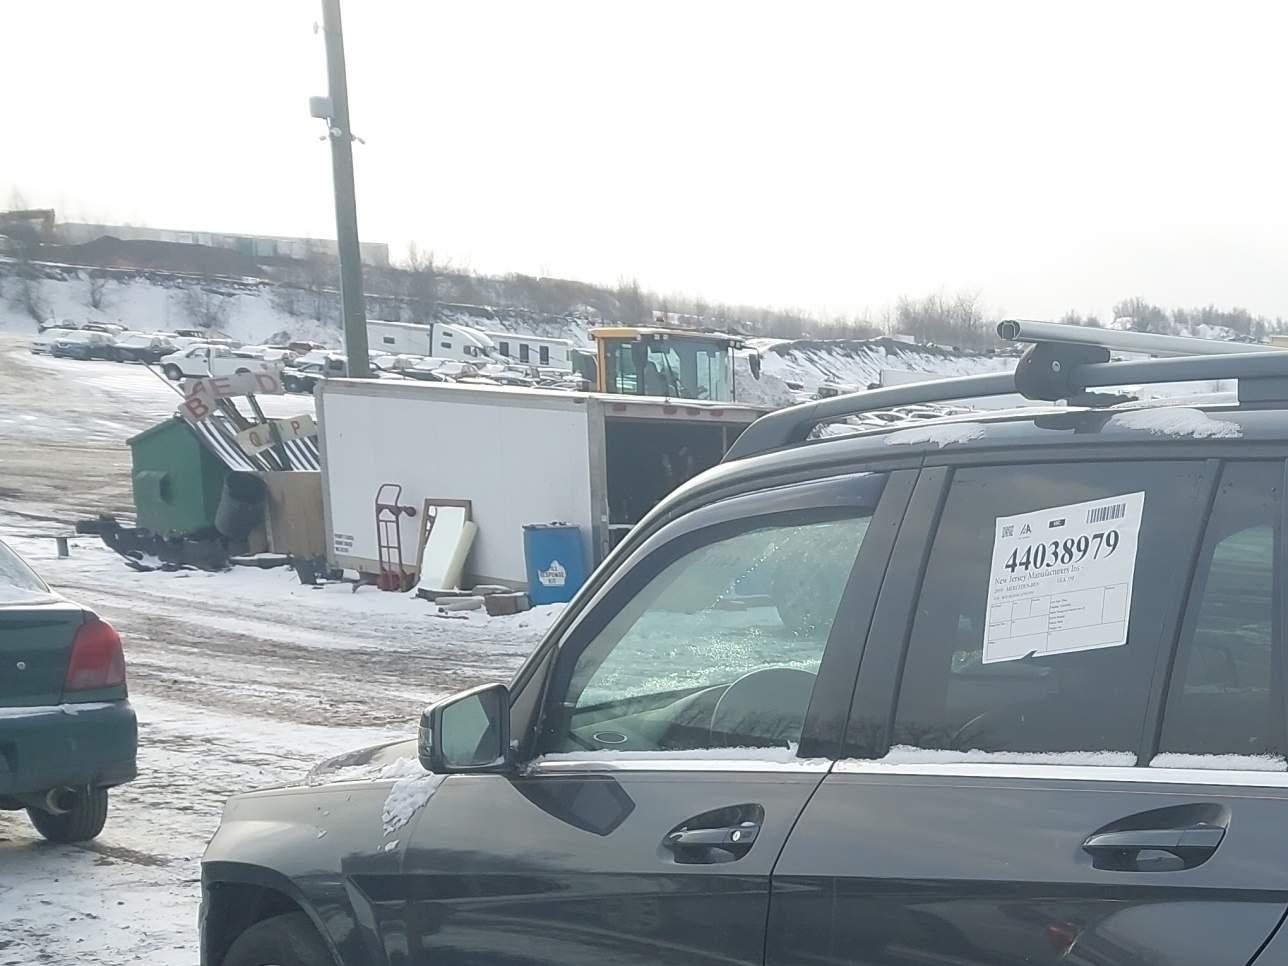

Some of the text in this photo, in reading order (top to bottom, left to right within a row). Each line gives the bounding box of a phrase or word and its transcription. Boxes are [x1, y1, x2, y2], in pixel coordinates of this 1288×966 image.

[256, 374, 279, 394] D
[187, 397, 209, 419] B
[291, 420, 300, 435] P
[1005, 530, 1119, 573] 44038979
[1009, 574, 1026, 584] Jersey
